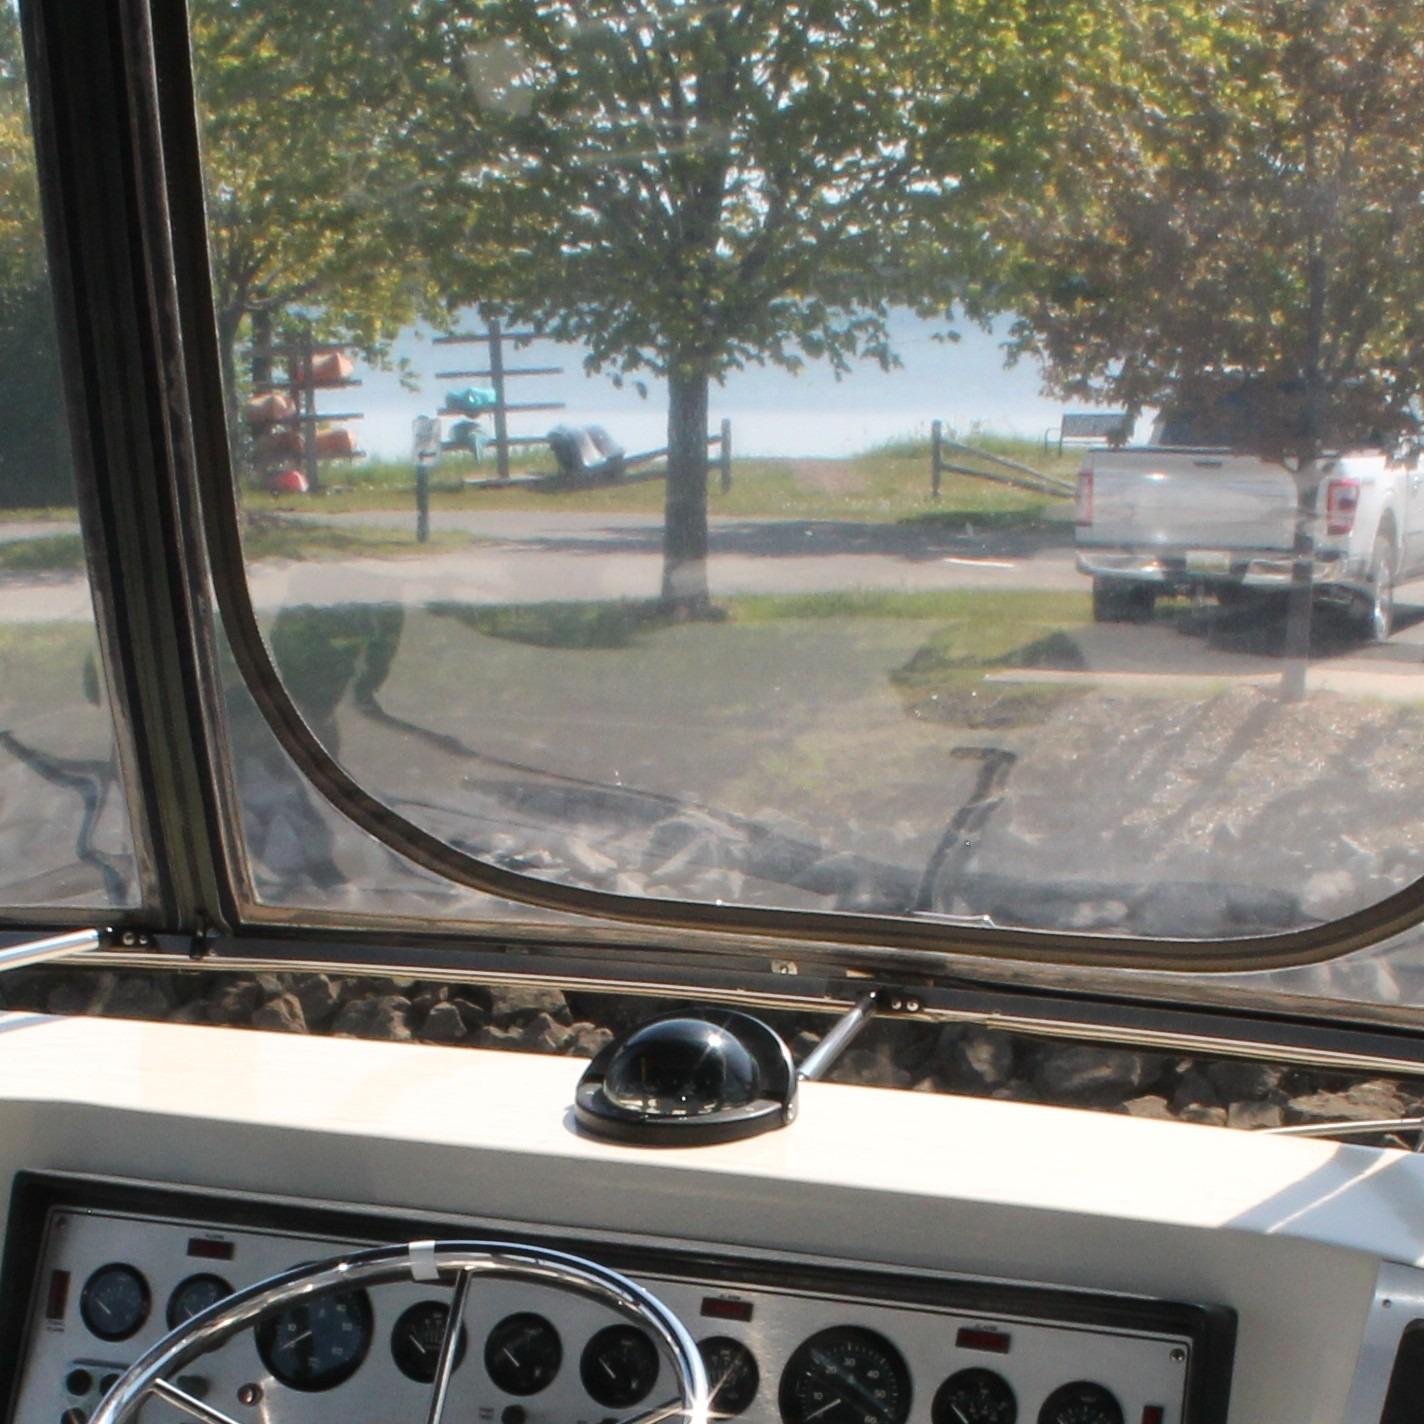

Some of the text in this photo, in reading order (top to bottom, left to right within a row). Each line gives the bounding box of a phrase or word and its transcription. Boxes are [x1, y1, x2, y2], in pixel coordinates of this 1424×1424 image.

[844, 1358, 856, 1367] 30
[867, 1370, 880, 1379] 40
[813, 1392, 824, 1400] 10
[863, 1416, 877, 1424] 60
